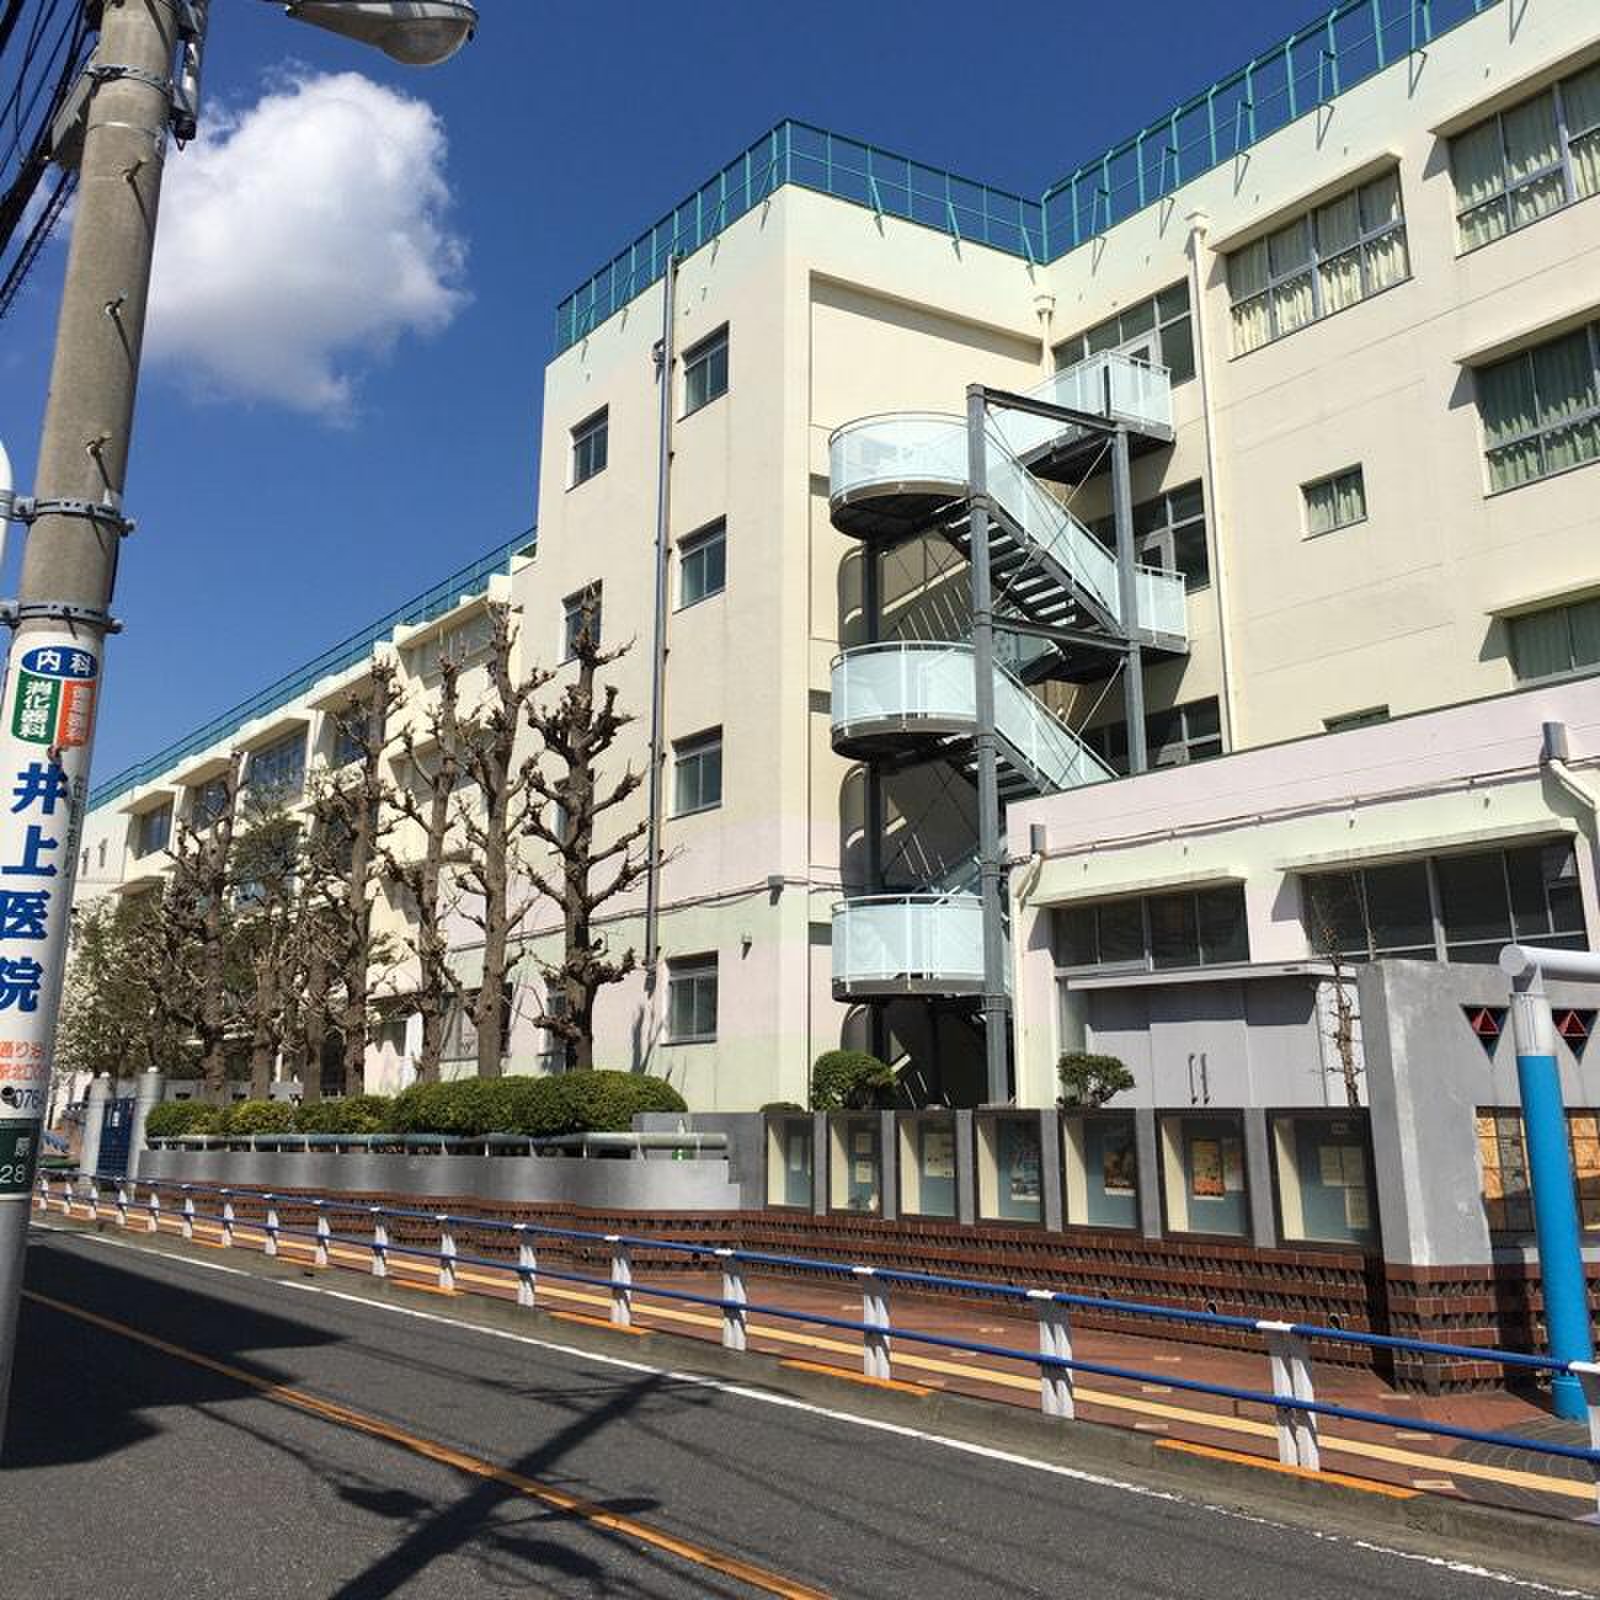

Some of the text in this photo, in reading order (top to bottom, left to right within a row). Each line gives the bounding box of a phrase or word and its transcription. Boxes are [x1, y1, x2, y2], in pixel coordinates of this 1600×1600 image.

[36, 649, 91, 676] 内科
[0, 762, 68, 1012] 井上医院
